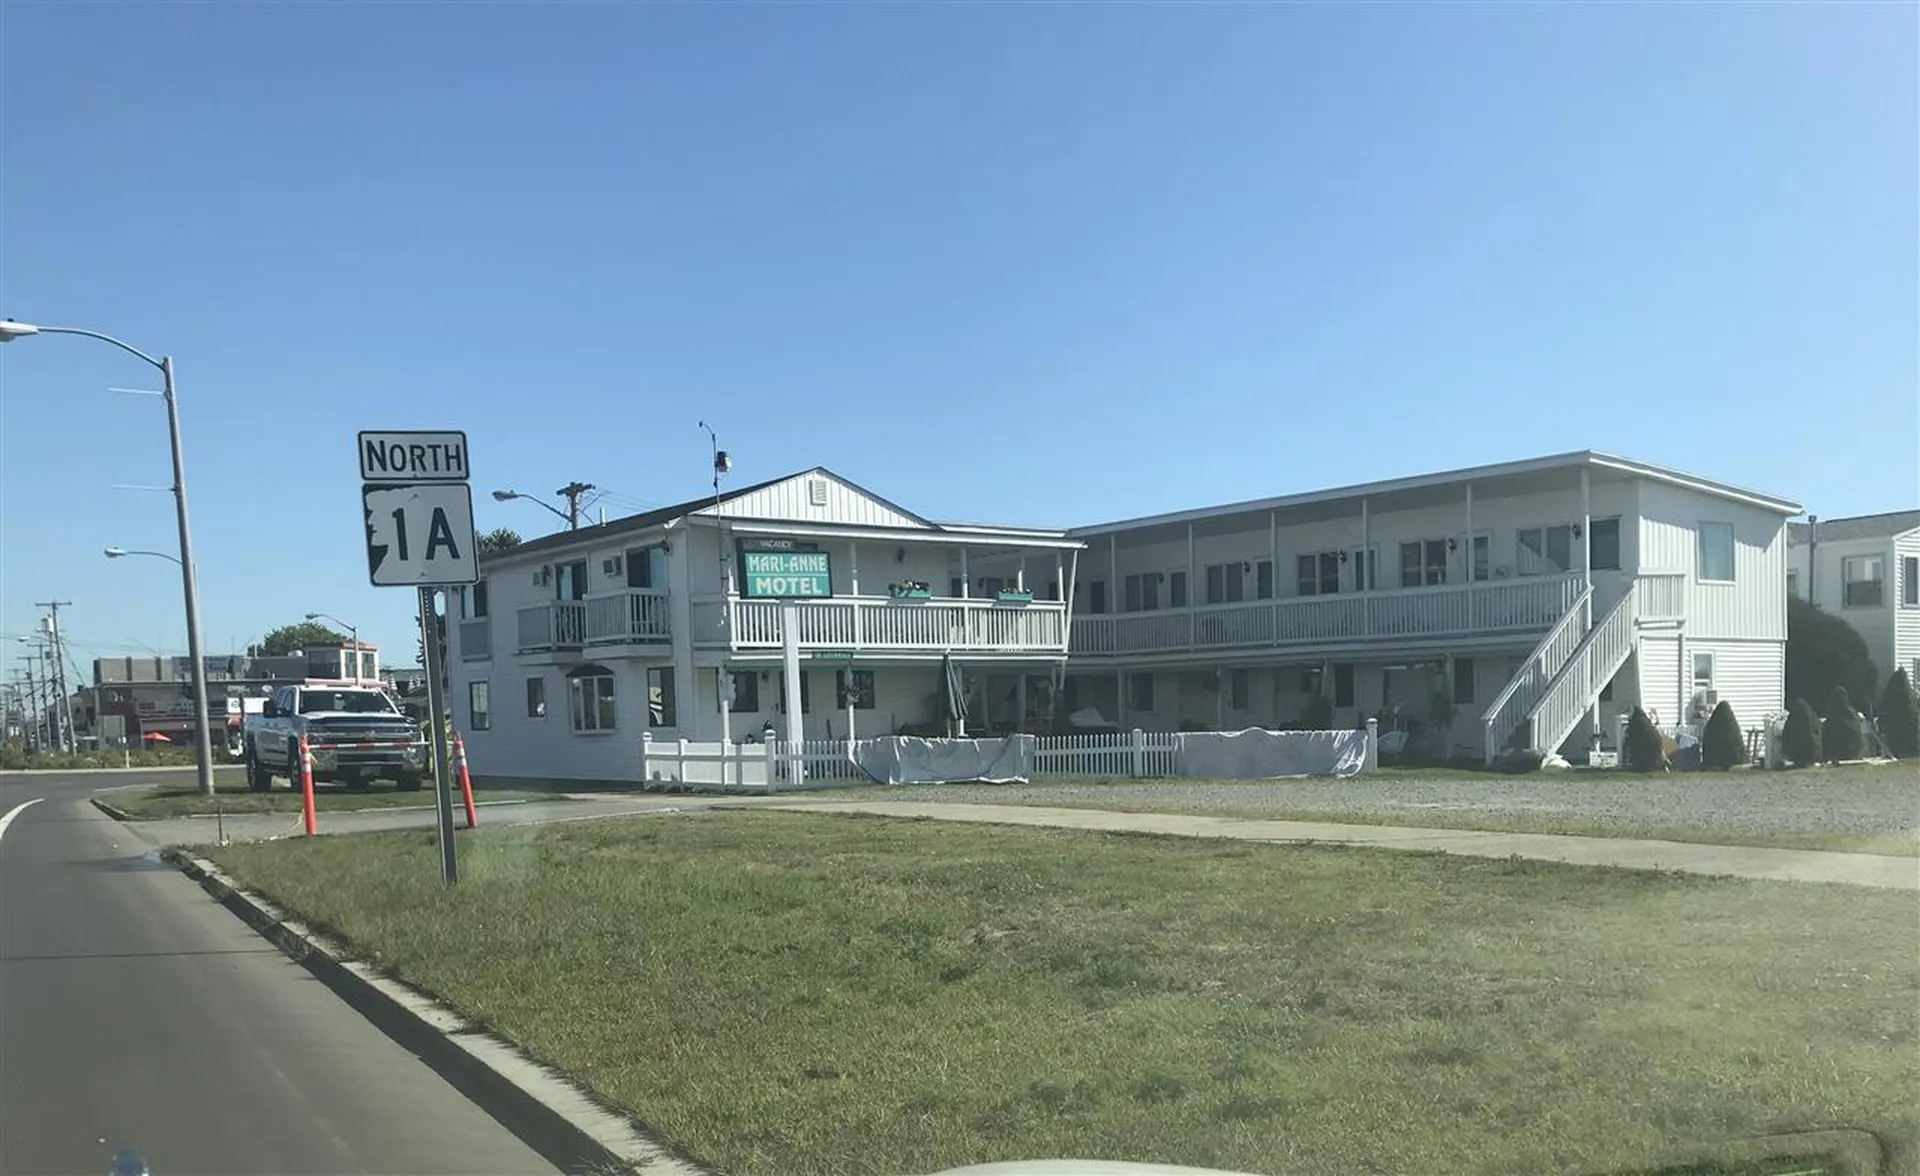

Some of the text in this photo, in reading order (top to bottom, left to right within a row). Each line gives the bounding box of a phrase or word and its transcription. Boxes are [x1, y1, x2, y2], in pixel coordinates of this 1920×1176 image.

[365, 439, 464, 472] NORTH
[391, 506, 461, 561] 1A
[748, 555, 828, 573] MARI-ANNE
[755, 577, 823, 595] MOTEL
